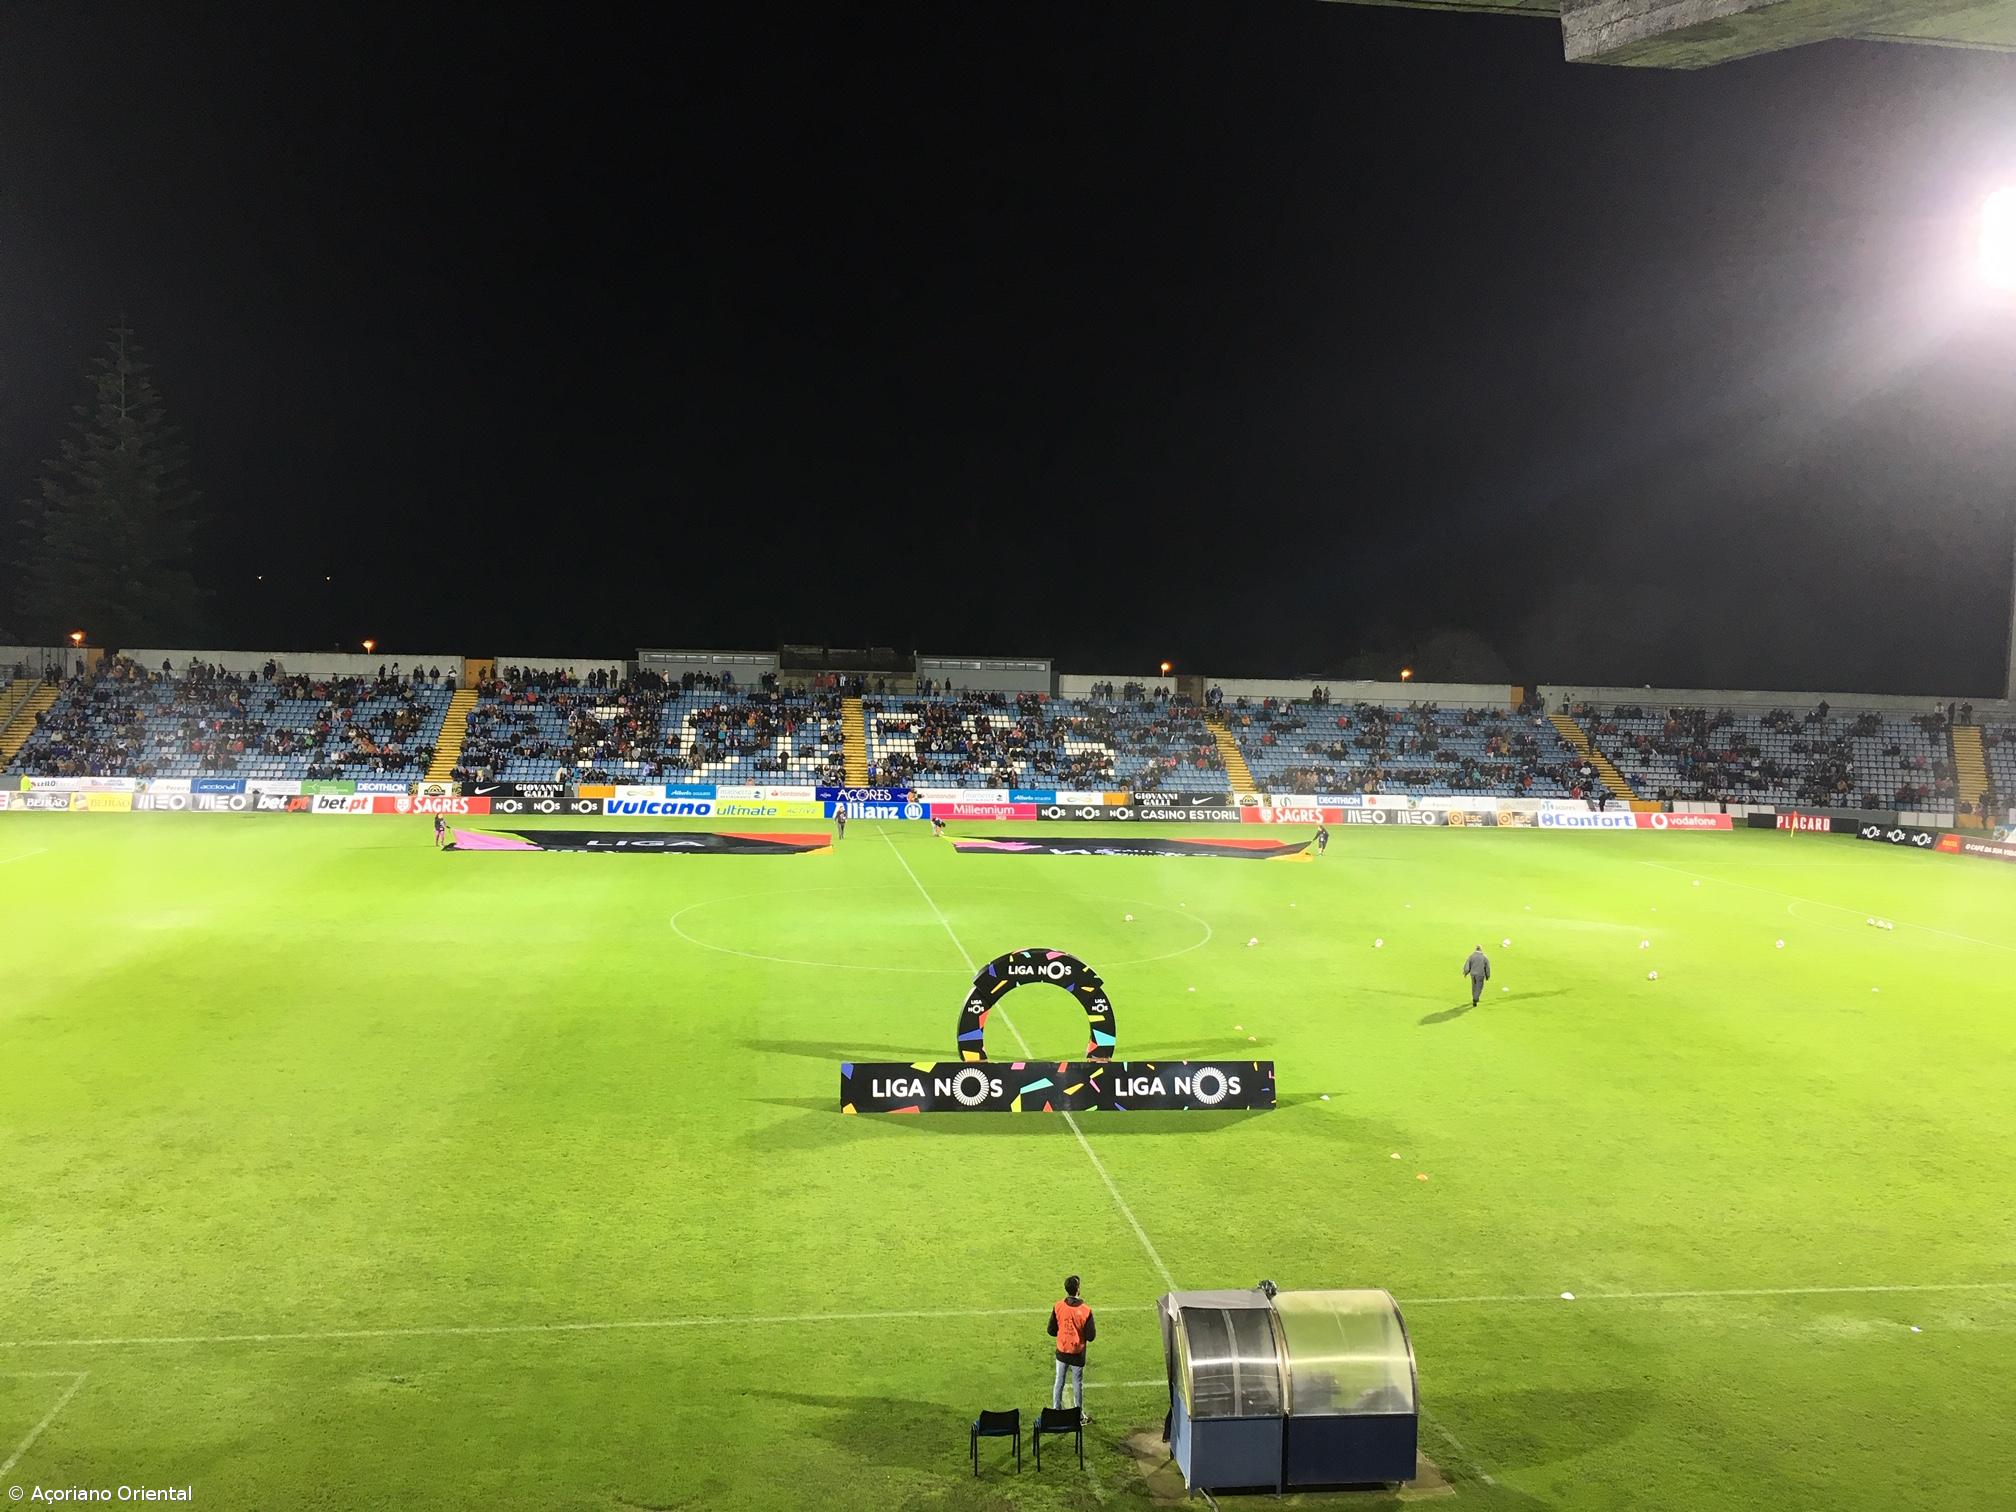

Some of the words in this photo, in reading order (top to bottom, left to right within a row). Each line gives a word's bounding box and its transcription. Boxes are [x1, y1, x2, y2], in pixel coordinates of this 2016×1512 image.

[357, 783, 406, 791] DECATHLON
[138, 795, 186, 809] MEO
[199, 795, 247, 810] MEO
[837, 789, 891, 802] AÇORES
[1135, 792, 1178, 800] GIOVANNI
[1319, 796, 1361, 805] DECATHLON
[257, 794, 309, 812] bet.pt
[318, 796, 368, 812] bet.pt
[413, 795, 469, 814] SAGRES
[496, 800, 523, 813] NOS
[534, 800, 560, 814] NOS
[571, 800, 598, 814] NOS
[607, 800, 711, 816] Vulcano
[716, 804, 777, 816] ultimate
[953, 804, 1015, 814] Millennium
[833, 802, 899, 819] Allianz
[1041, 806, 1066, 819] NOS
[1075, 806, 1101, 820] NOS
[1109, 807, 1134, 820] NOS
[1140, 810, 1186, 820] CASINO
[1189, 810, 1240, 820] ESTORIL
[1275, 807, 1324, 824] SAGRES
[1347, 810, 1386, 824] MEO
[1397, 811, 1436, 825] MEO
[1670, 815, 1717, 826] vodafone
[1776, 815, 1831, 831] PLACARD
[1862, 826, 1881, 838] NOS
[1886, 829, 1906, 842] NOS
[1912, 833, 1933, 845] NOS
[1008, 965, 1034, 975] LIGA
[1038, 961, 1072, 980] NOS
[968, 1005, 985, 1014] NOS
[1091, 1004, 1108, 1013] NOS
[872, 1078, 926, 1097] LIGA
[934, 1068, 1003, 1106] NOS
[1115, 1077, 1166, 1097] LIGA
[1174, 1066, 1241, 1104] NOS
